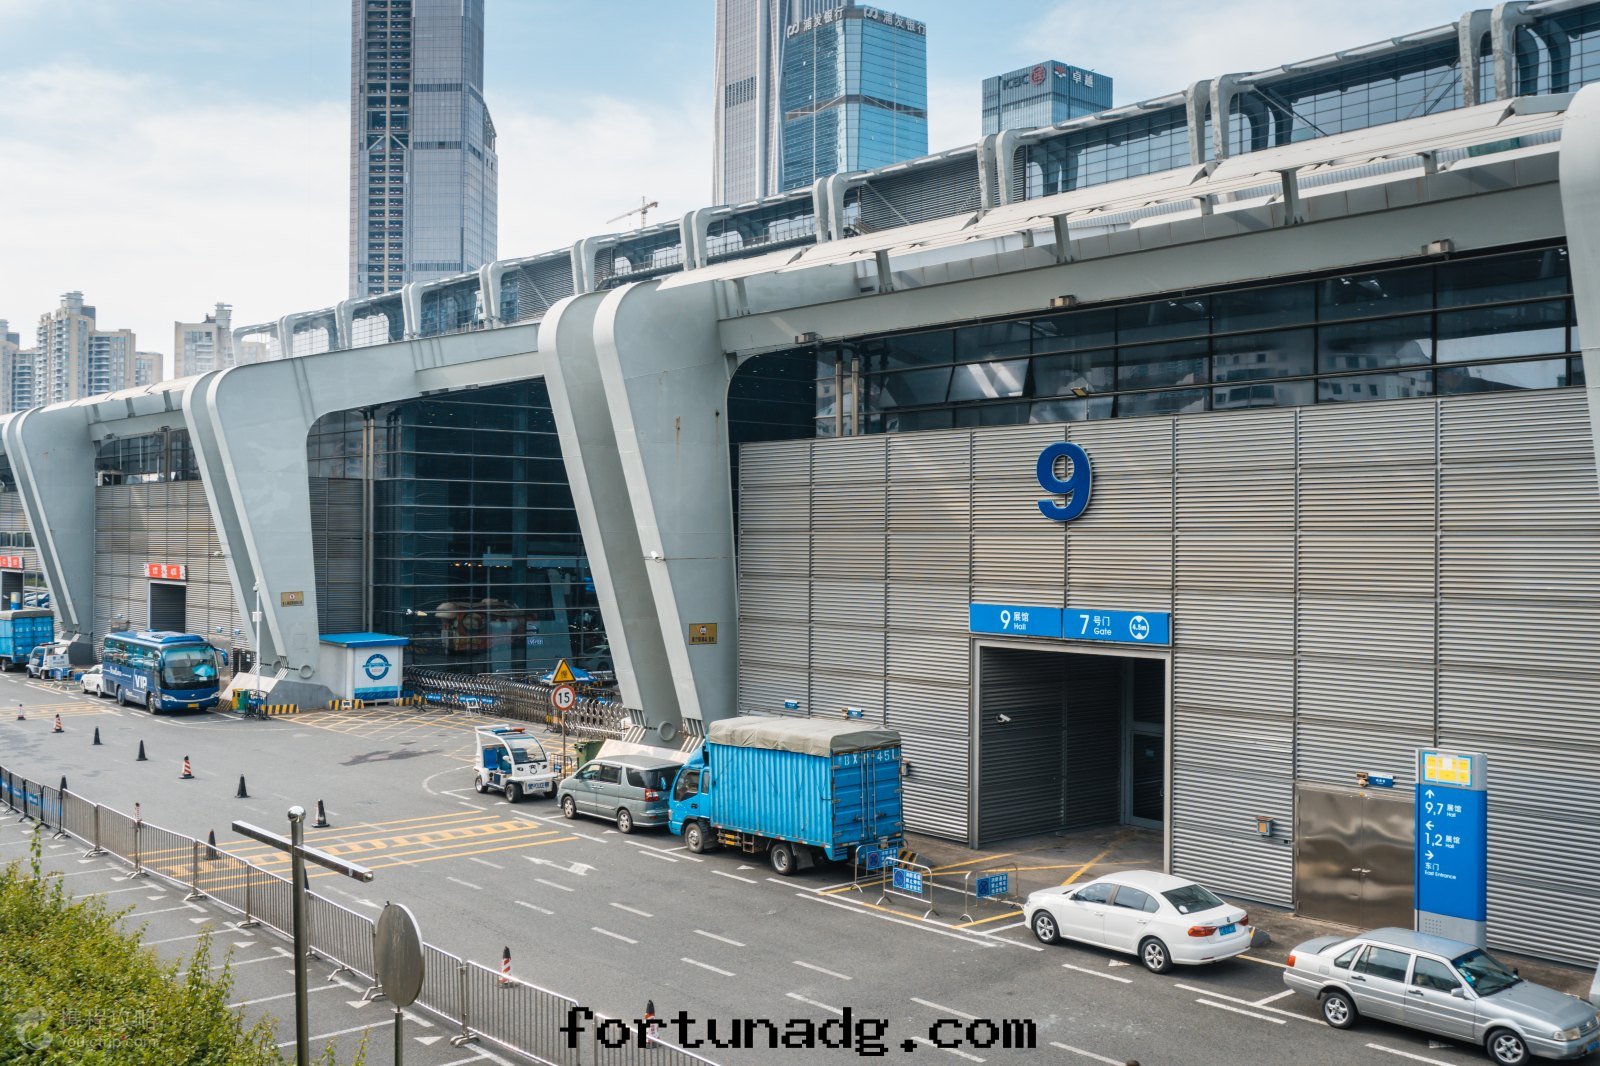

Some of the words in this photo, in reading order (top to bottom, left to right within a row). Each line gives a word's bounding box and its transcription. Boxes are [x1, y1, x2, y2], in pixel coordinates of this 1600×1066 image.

[803, 6, 844, 32] 浦发银行
[883, 11, 927, 35] 浦发银行
[1036, 441, 1092, 522] 9
[1000, 609, 1011, 630] 9
[1013, 611, 1029, 622] 展馆
[1093, 616, 1111, 627] 号门
[1013, 622, 1027, 631] Hall
[1079, 614, 1090, 635] 7
[1093, 627, 1112, 637] Gate
[134, 674, 148, 689] VIP
[558, 692, 570, 704] 15
[1446, 803, 1462, 813] 展馆
[1445, 835, 1461, 845] 展馆
[1425, 862, 1440, 871] 东门
[1435, 871, 1457, 880] Entrance
